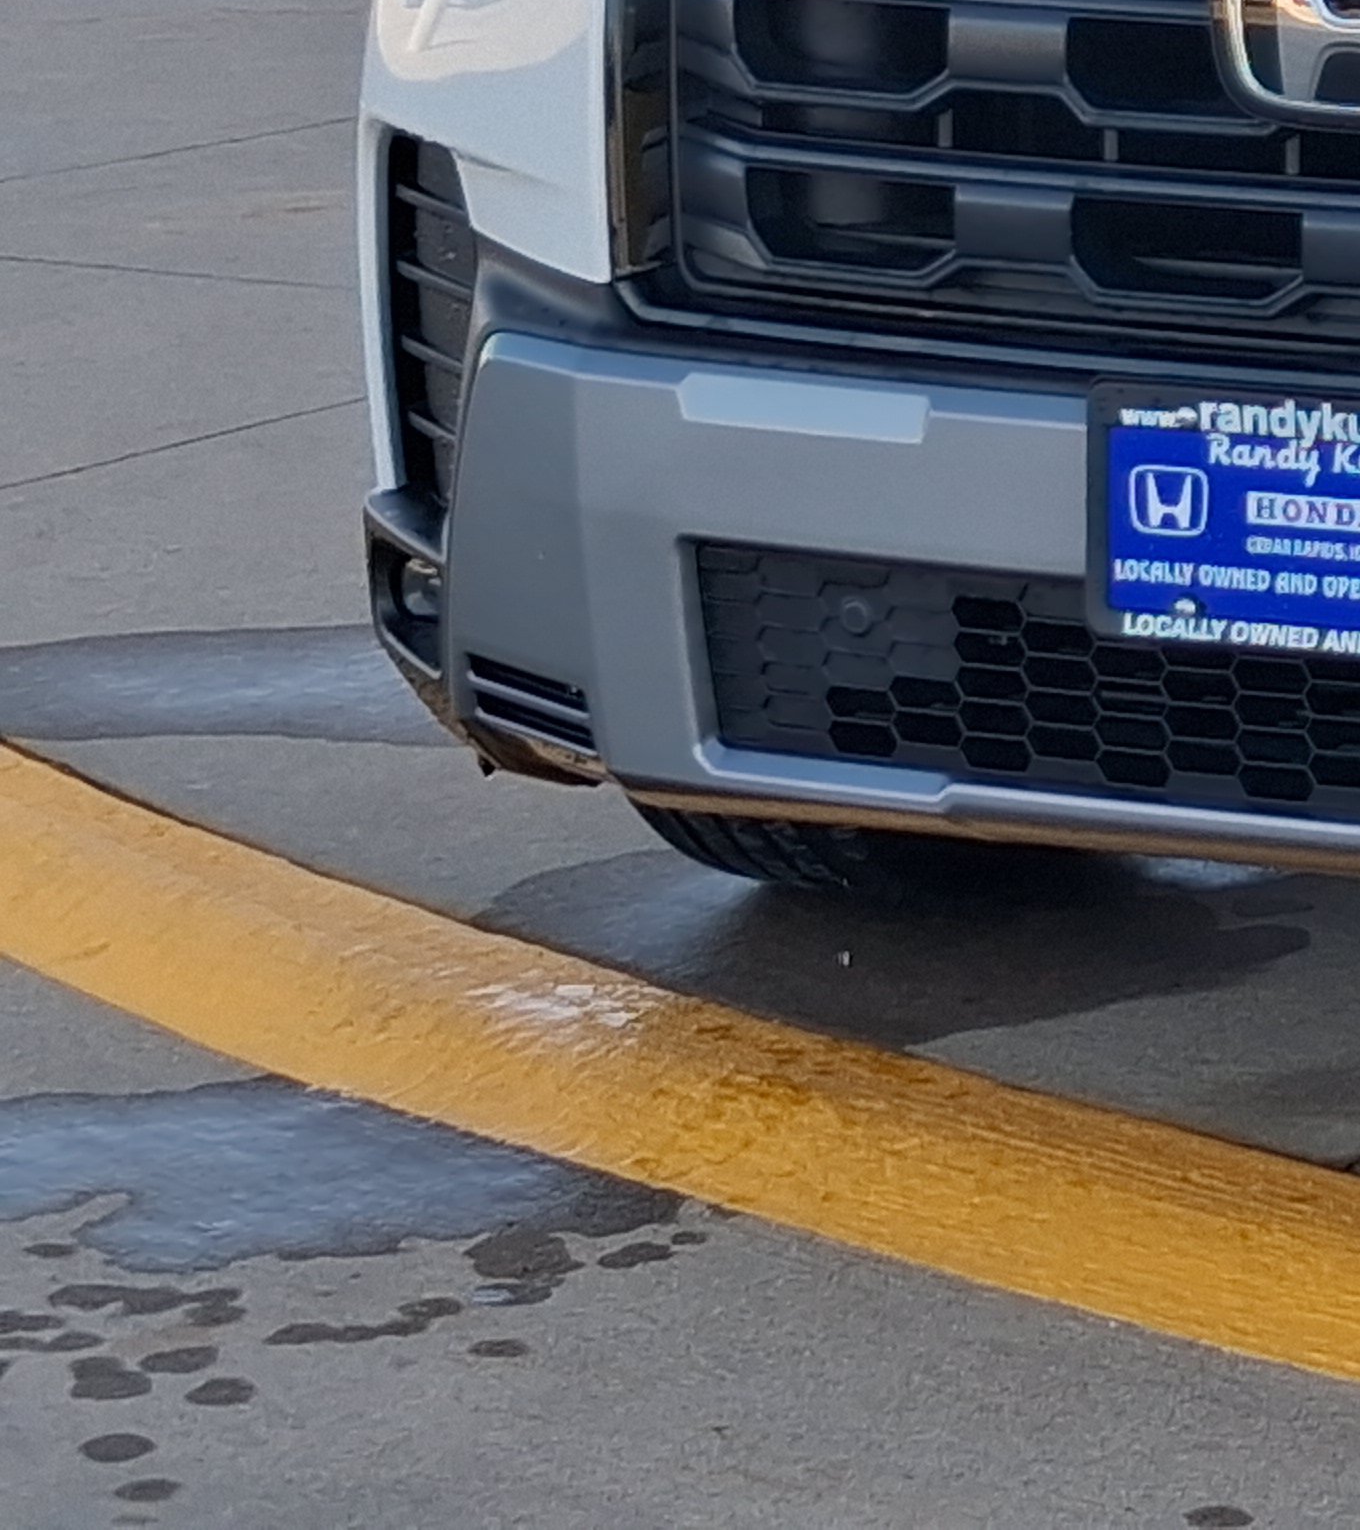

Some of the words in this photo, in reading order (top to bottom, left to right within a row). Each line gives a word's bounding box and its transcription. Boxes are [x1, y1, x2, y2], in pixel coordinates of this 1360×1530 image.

[1205, 432, 1319, 488] Randy
[1114, 558, 1194, 586] LOCALLY
[1199, 564, 1271, 592] OWNED
[1274, 571, 1318, 596] AND
[1121, 612, 1229, 641] LOCALLY
[1230, 620, 1320, 649] OWNED
